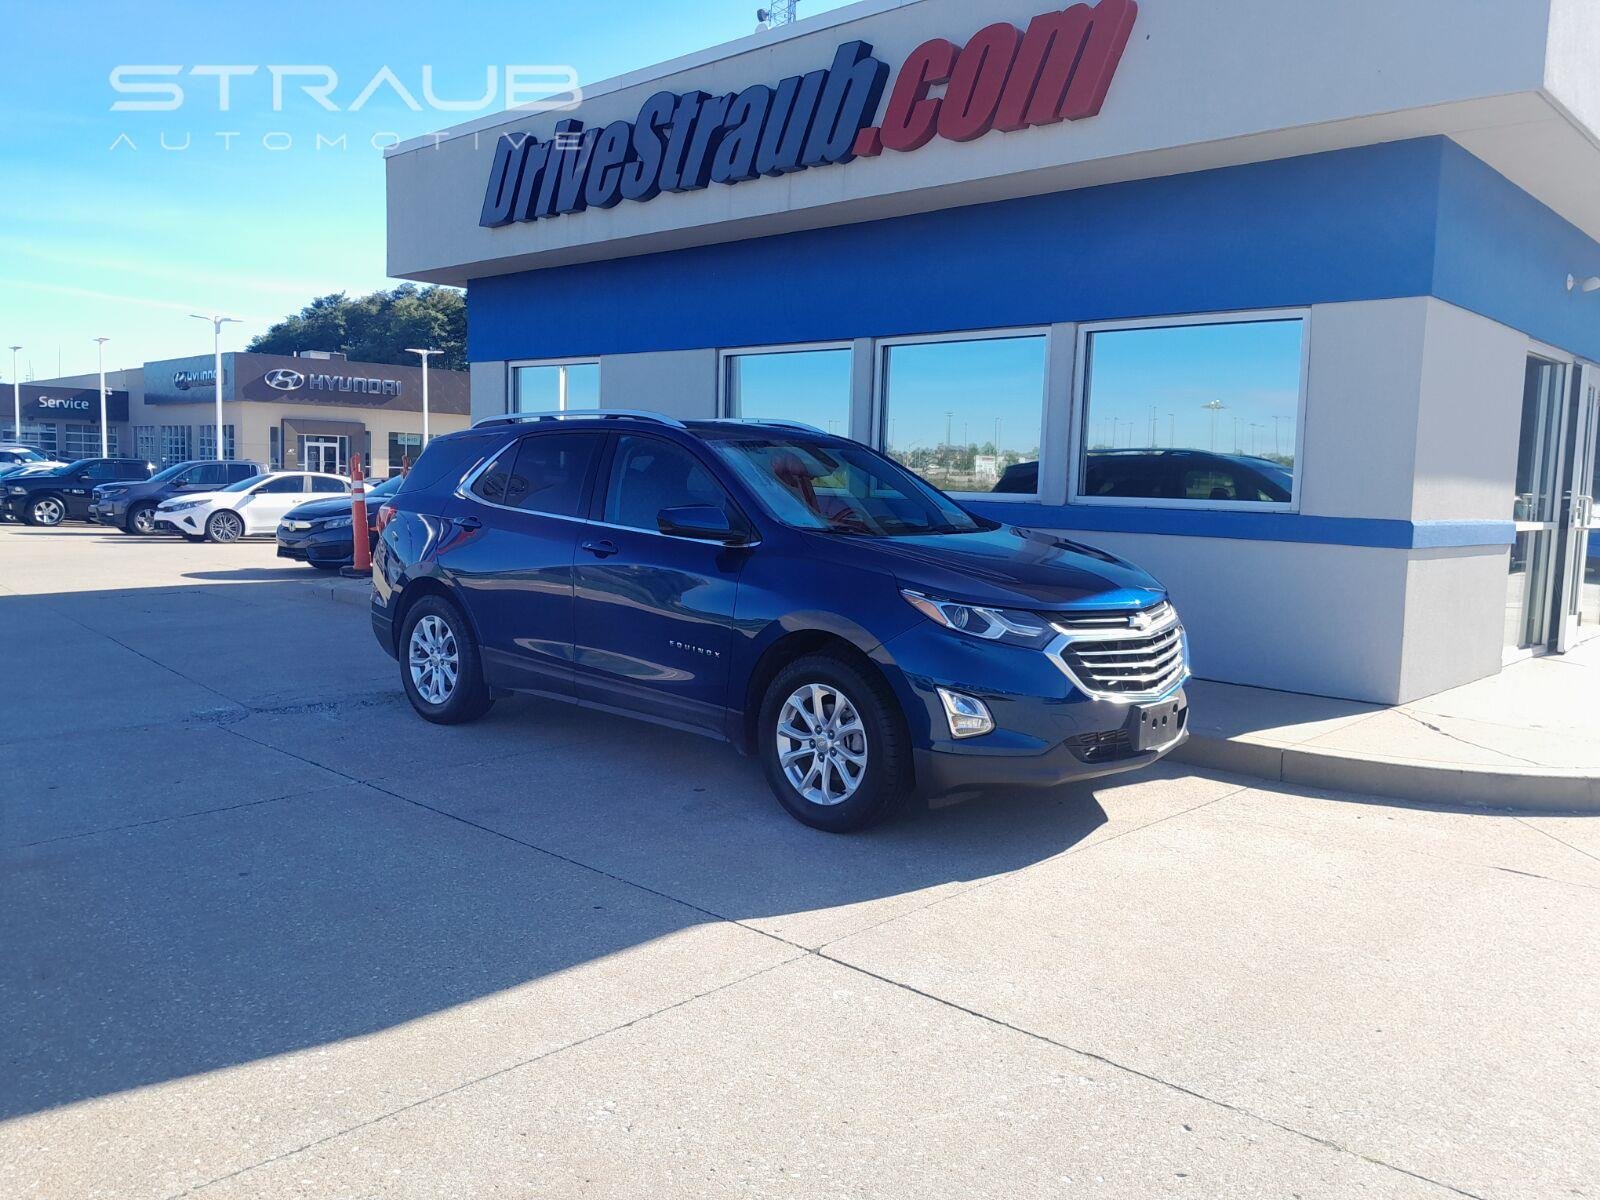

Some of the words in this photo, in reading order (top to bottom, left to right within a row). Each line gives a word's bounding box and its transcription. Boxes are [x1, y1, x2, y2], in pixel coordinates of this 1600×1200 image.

[479, 0, 1138, 228] DriveStraub.com
[309, 373, 402, 396] HYUNDAI
[38, 396, 89, 410] Service
[669, 639, 721, 658] EQUINOX
